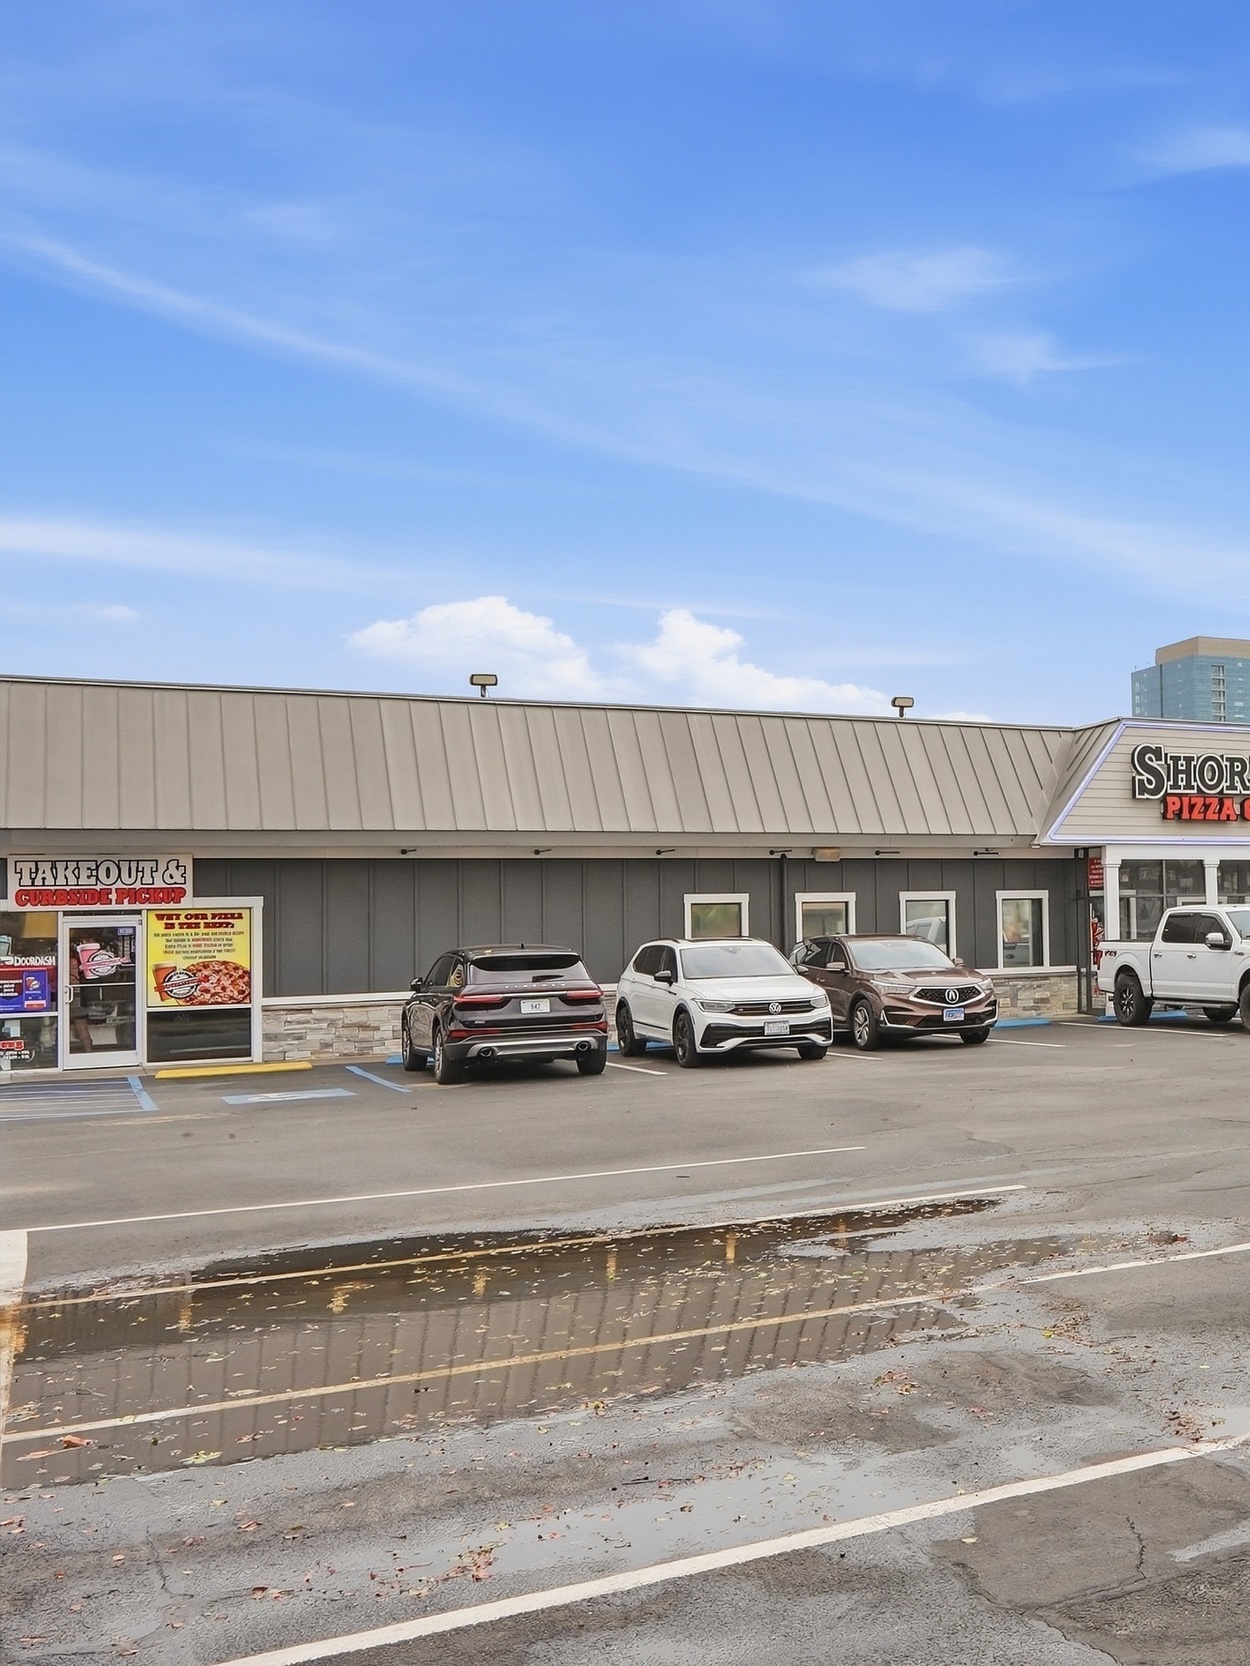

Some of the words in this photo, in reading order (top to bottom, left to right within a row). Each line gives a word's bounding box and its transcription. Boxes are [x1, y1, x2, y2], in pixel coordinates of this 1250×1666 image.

[1163, 796, 1238, 822] PIZZA
[15, 860, 158, 886] TAKEOUT
[162, 859, 187, 885] &
[15, 888, 112, 906] CURBSIDE
[115, 887, 186, 904] PICKUP
[14, 956, 56, 966] DOORDASH
